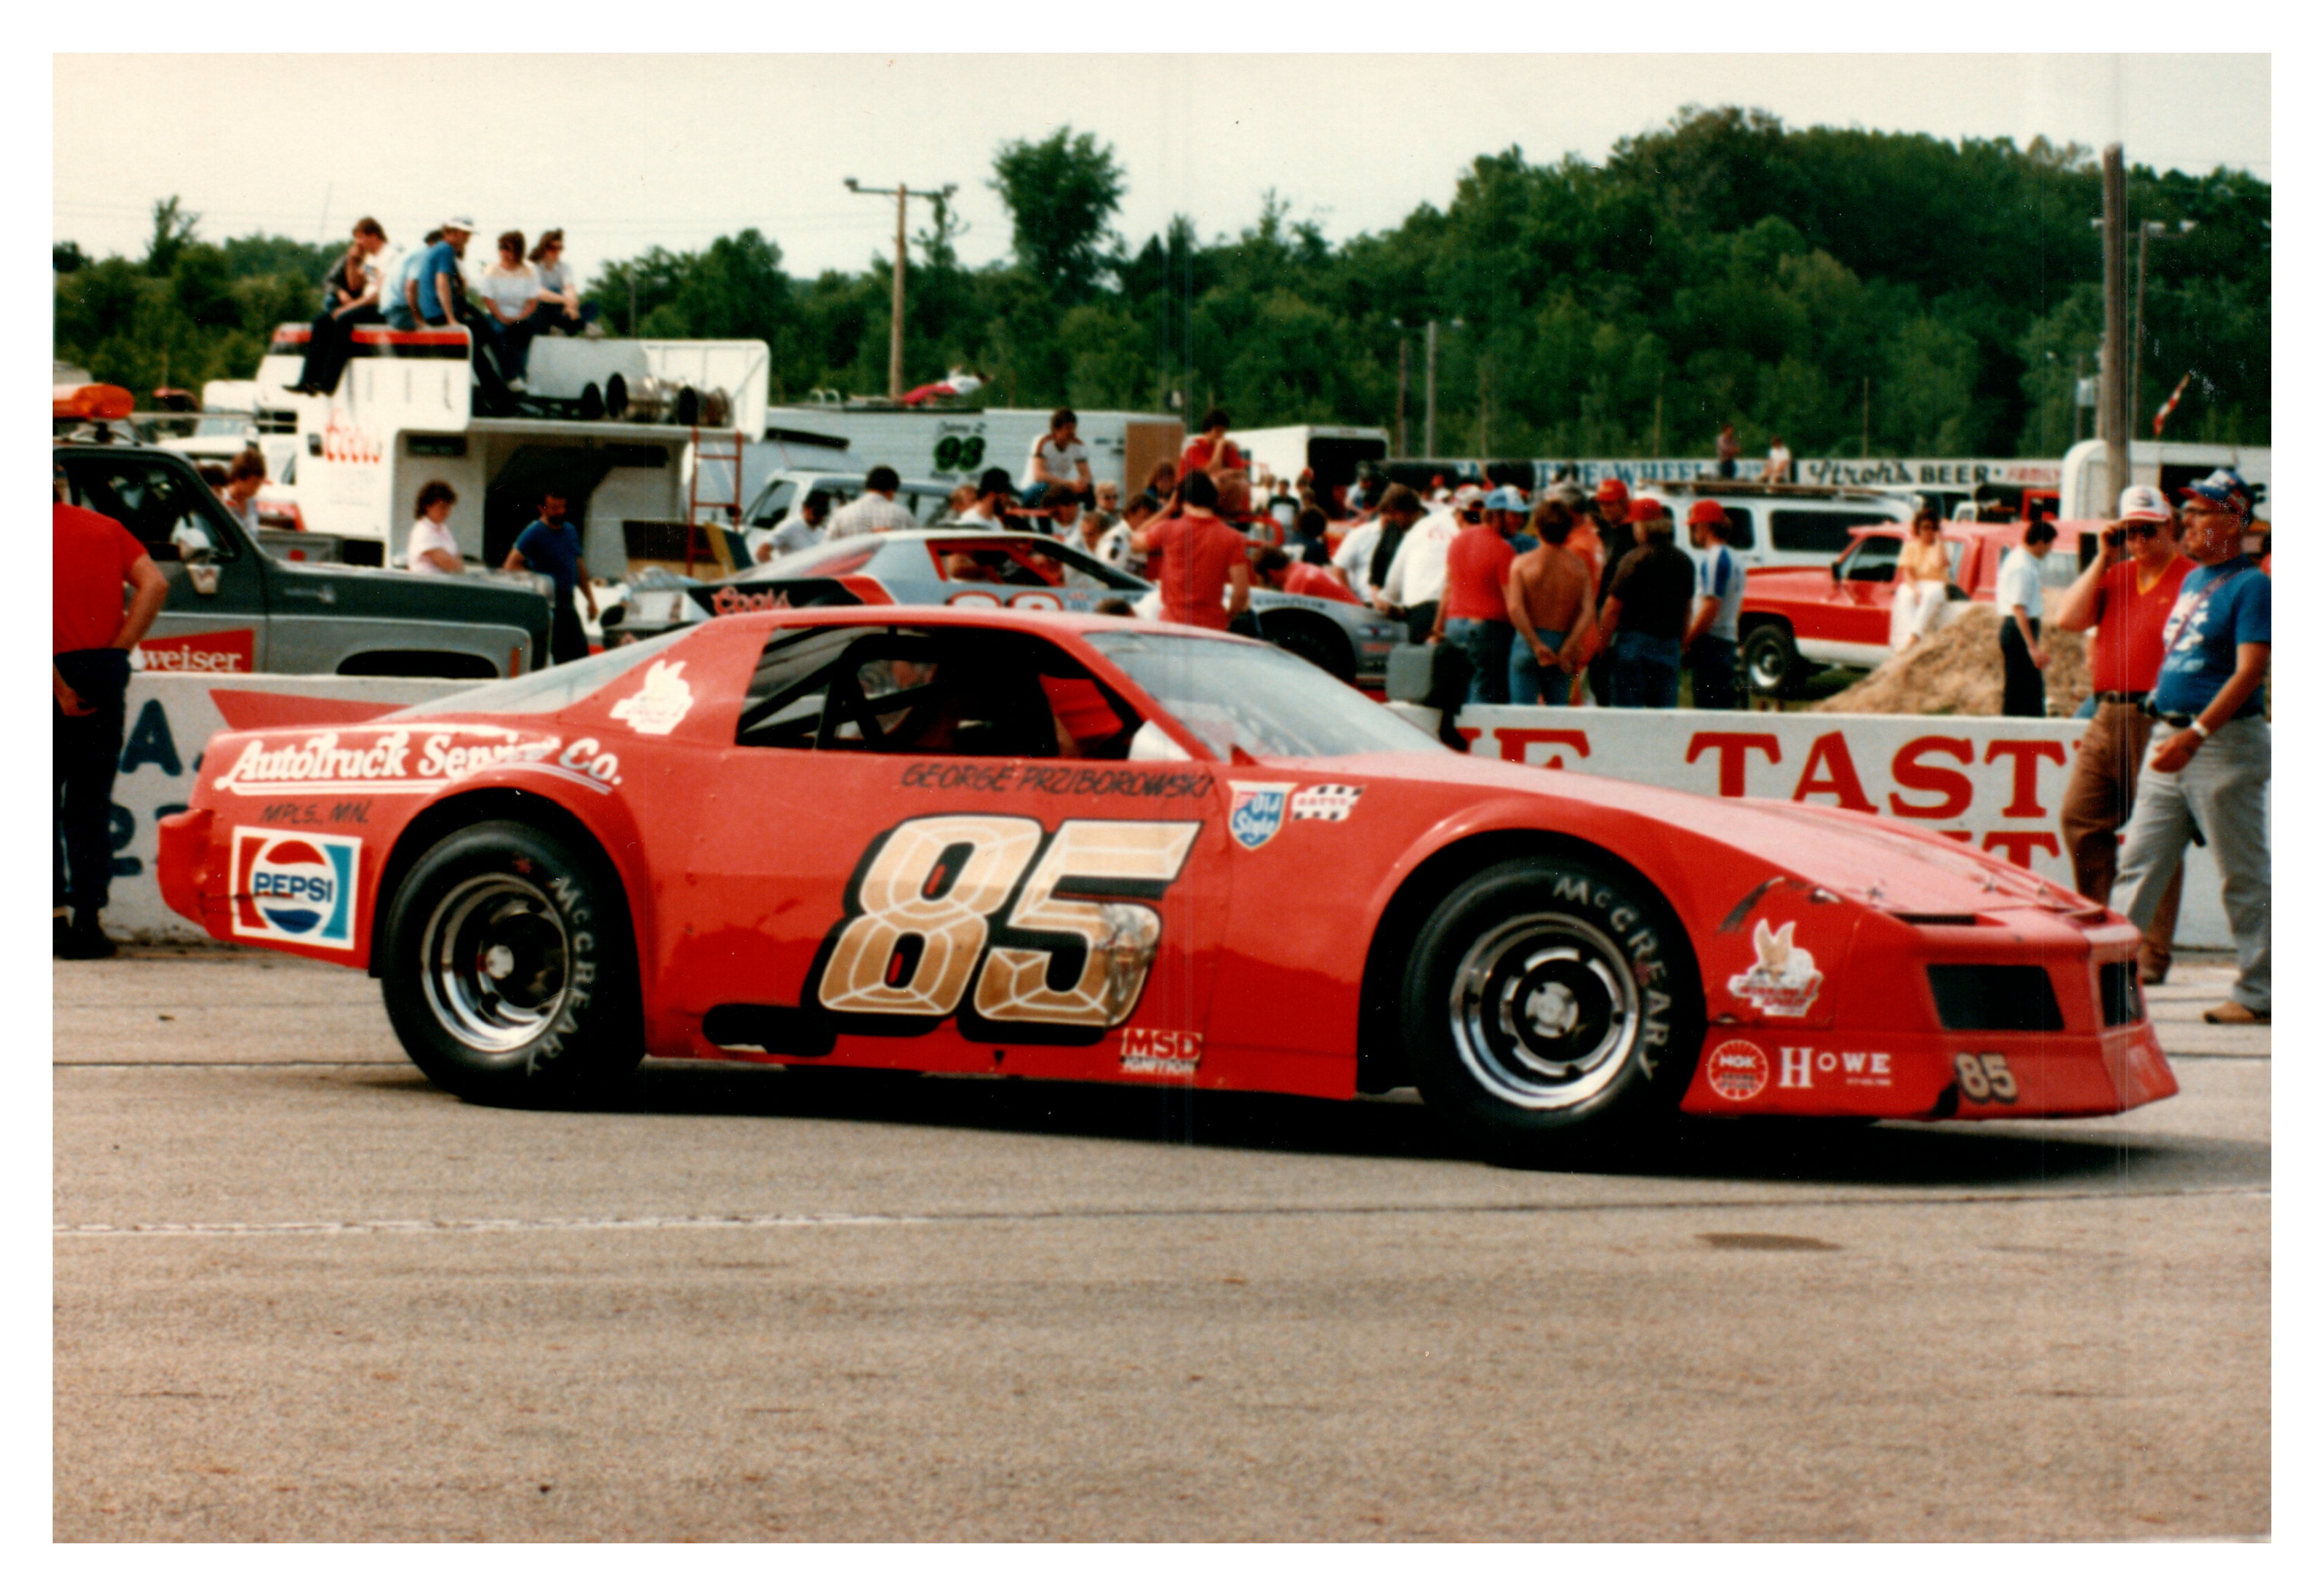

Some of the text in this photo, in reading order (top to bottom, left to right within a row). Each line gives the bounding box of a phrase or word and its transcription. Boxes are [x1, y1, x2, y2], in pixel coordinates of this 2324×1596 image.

[1920, 465, 1989, 484] BEER
[143, 645, 242, 670] weiser
[559, 737, 622, 785] Co.
[1685, 731, 2081, 819] TAST
[901, 764, 1014, 791] GEORGE
[254, 872, 333, 902] PEPSI
[818, 813, 1205, 1028] 85
[1121, 1028, 1202, 1058] MSD
[1719, 1054, 1757, 1068] NGK
[1778, 1047, 1891, 1088] HOWE
[1954, 1052, 2019, 1104] 85
